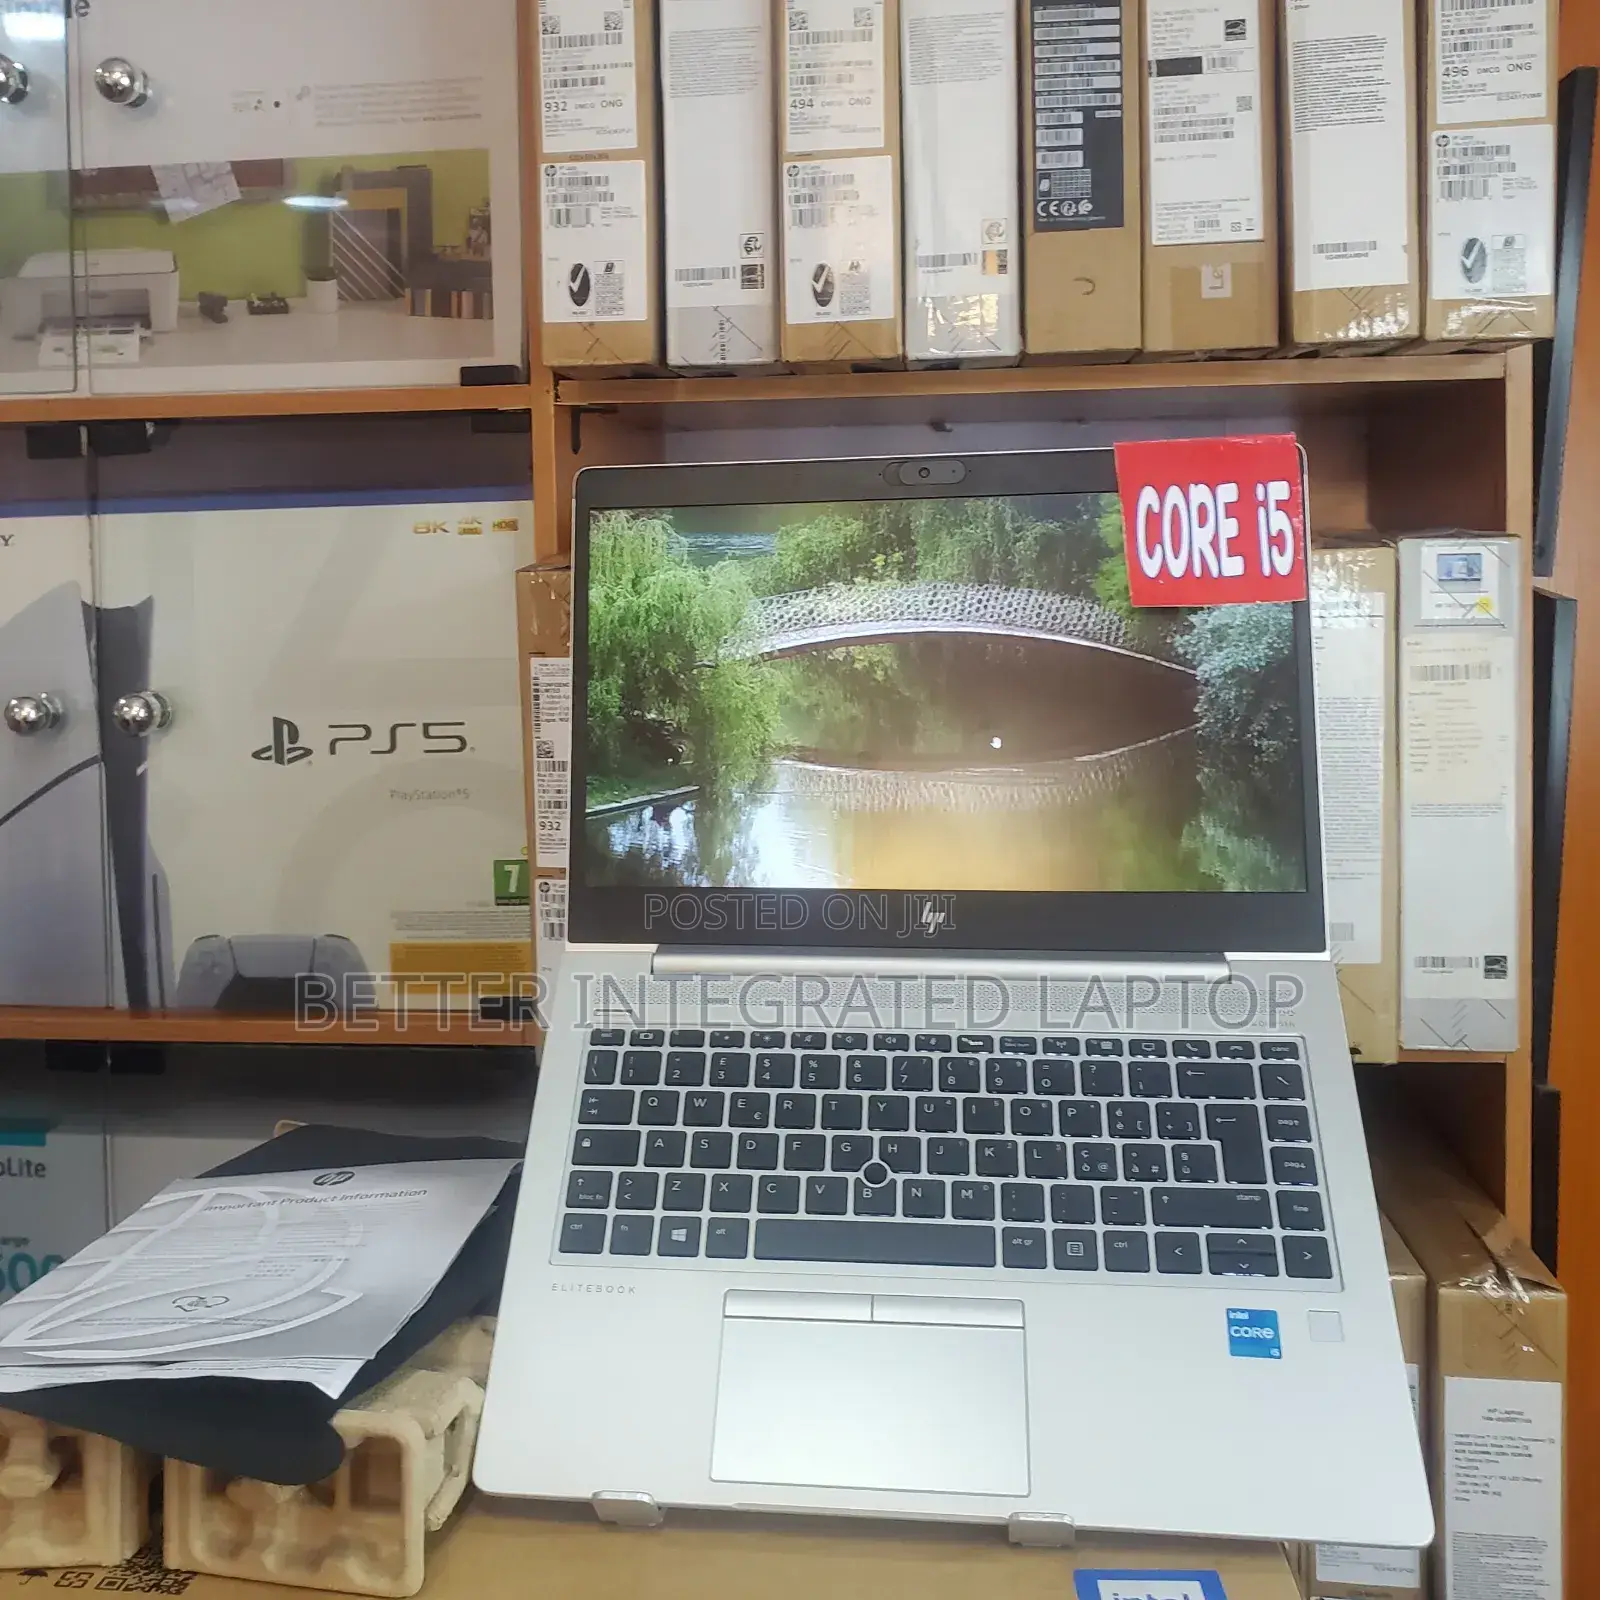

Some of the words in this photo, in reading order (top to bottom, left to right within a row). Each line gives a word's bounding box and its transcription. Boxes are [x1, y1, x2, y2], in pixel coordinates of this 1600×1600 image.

[1441, 66, 1469, 77] 496
[1506, 62, 1533, 72] ONG
[544, 101, 568, 112] 932
[600, 99, 623, 108] ONG
[788, 98, 814, 109] 494
[413, 520, 450, 534] 8K
[1136, 482, 1245, 579] CORE
[1255, 480, 1295, 577] i5
[328, 721, 468, 755] PS5
[539, 820, 561, 831] 932
[503, 864, 520, 893] 7
[673, 1070, 680, 1078] 2
[718, 1071, 725, 1079] 3
[808, 1073, 815, 1081] 5
[854, 1074, 861, 1082] 6
[900, 1075, 908, 1083] 7
[948, 1076, 955, 1084] 8
[648, 1097, 658, 1106] Q
[694, 1098, 707, 1107] W
[738, 1099, 746, 1108] E
[784, 1101, 792, 1109] R
[830, 1101, 838, 1110] T
[877, 1102, 886, 1111] Y
[924, 1104, 934, 1112] U
[1020, 1107, 1031, 1115] O
[1067, 1108, 1076, 1117] P
[655, 1139, 664, 1147] A
[700, 1139, 708, 1148] S
[746, 1140, 756, 1149] D
[793, 1142, 801, 1150] F
[841, 1143, 851, 1151] G
[888, 1144, 897, 1153] H
[936, 1146, 943, 1154] J
[985, 1148, 994, 1156] K
[1033, 1149, 1042, 1158] L
[672, 1181, 681, 1190] Z
[719, 1183, 729, 1191] X
[767, 1183, 776, 1193] C
[815, 1185, 825, 1194] V
[279, 1194, 337, 1205] Product
[338, 1188, 428, 1202] Information
[863, 1188, 872, 1198] B
[912, 1188, 921, 1197] N
[961, 1190, 973, 1199] M
[1235, 1194, 1262, 1202] stamp
[620, 1224, 629, 1232] fn
[1113, 1241, 1128, 1249] ctrl
[551, 1282, 636, 1295] ELITEBOOK
